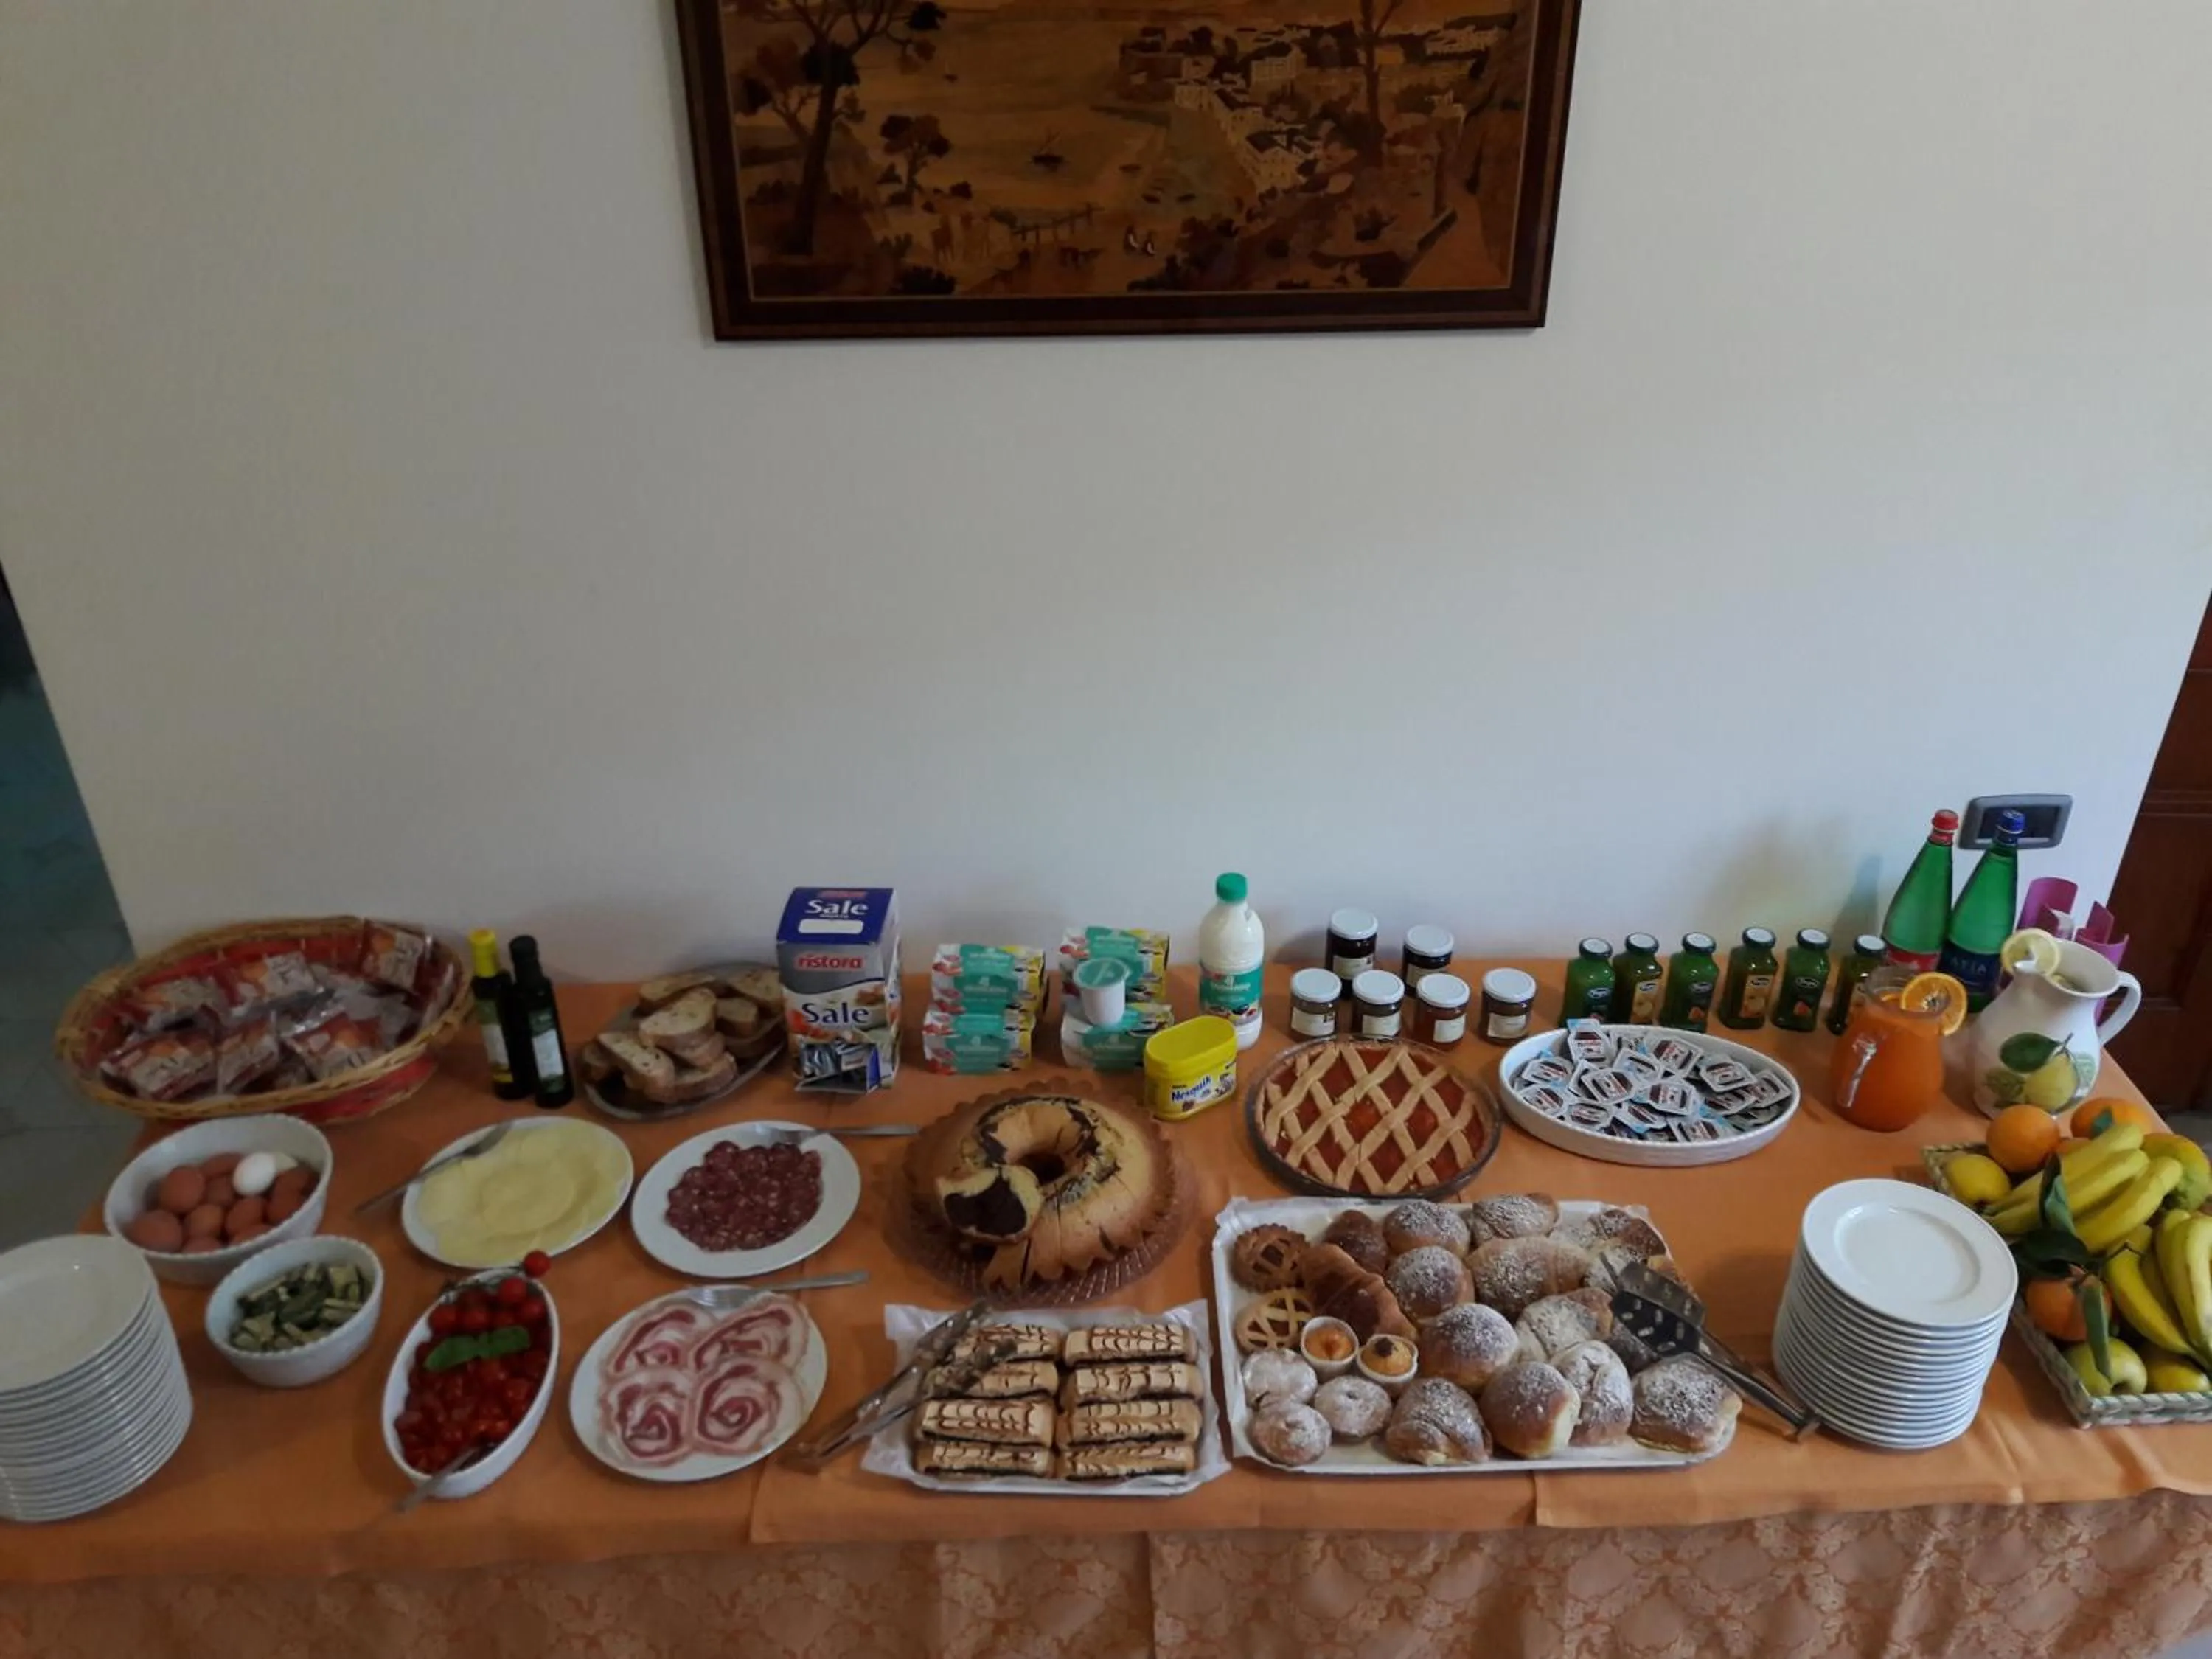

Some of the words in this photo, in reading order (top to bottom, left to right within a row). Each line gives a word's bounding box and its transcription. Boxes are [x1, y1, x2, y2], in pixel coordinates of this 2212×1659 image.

[804, 898, 869, 916] Sale
[797, 954, 864, 970] ristora
[801, 1001, 870, 1024] Sale
